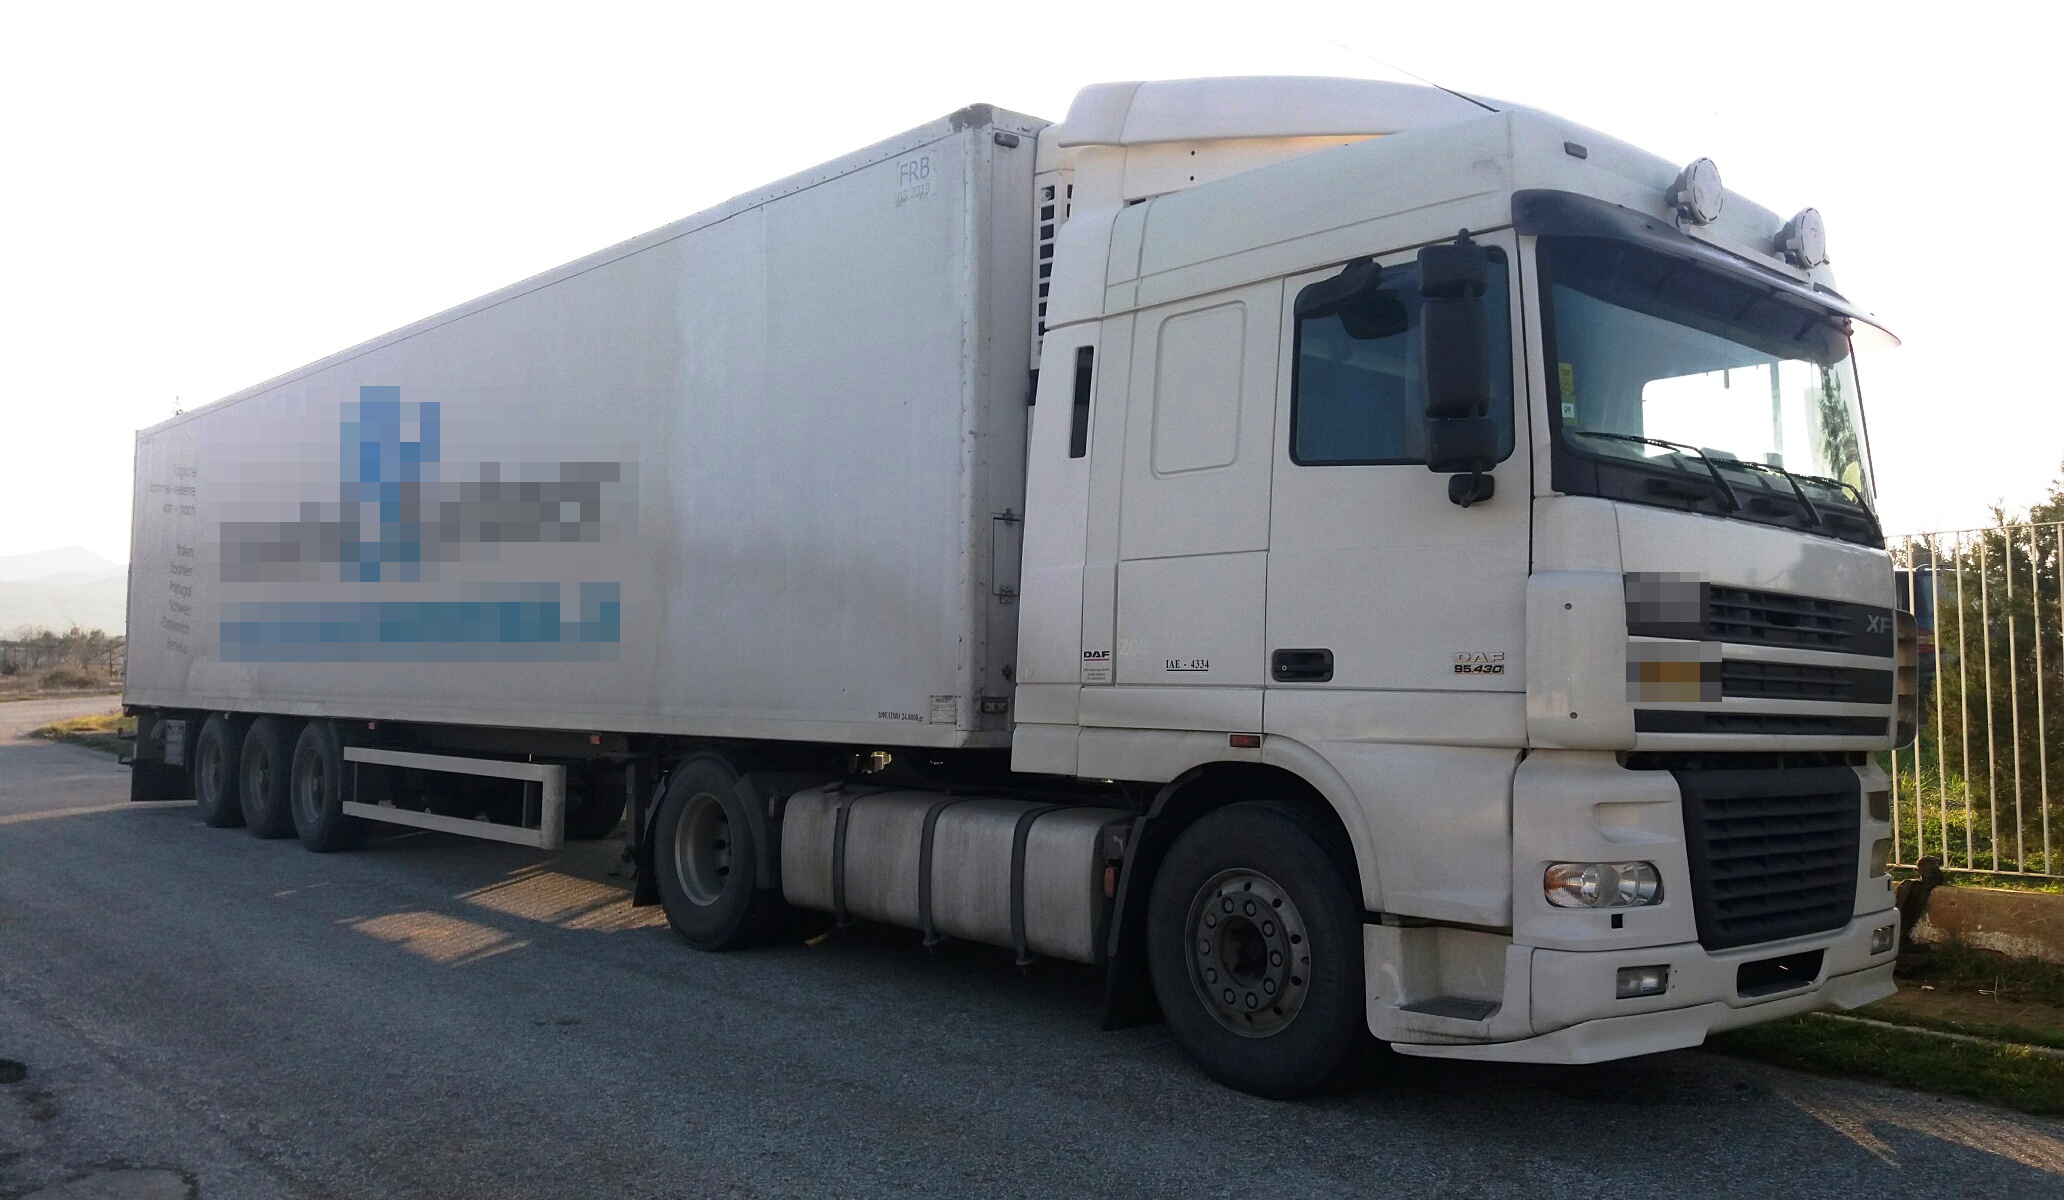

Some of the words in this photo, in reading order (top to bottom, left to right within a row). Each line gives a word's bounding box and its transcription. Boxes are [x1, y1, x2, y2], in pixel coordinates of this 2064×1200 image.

[900, 156, 930, 187] FRB
[1865, 614, 1891, 635] XF
[1083, 650, 1110, 658] DAF
[1454, 651, 1505, 663] DAF
[1165, 659, 1181, 669] IAE
[1190, 659, 1209, 669] 4334
[1454, 664, 1503, 674] 95.430
